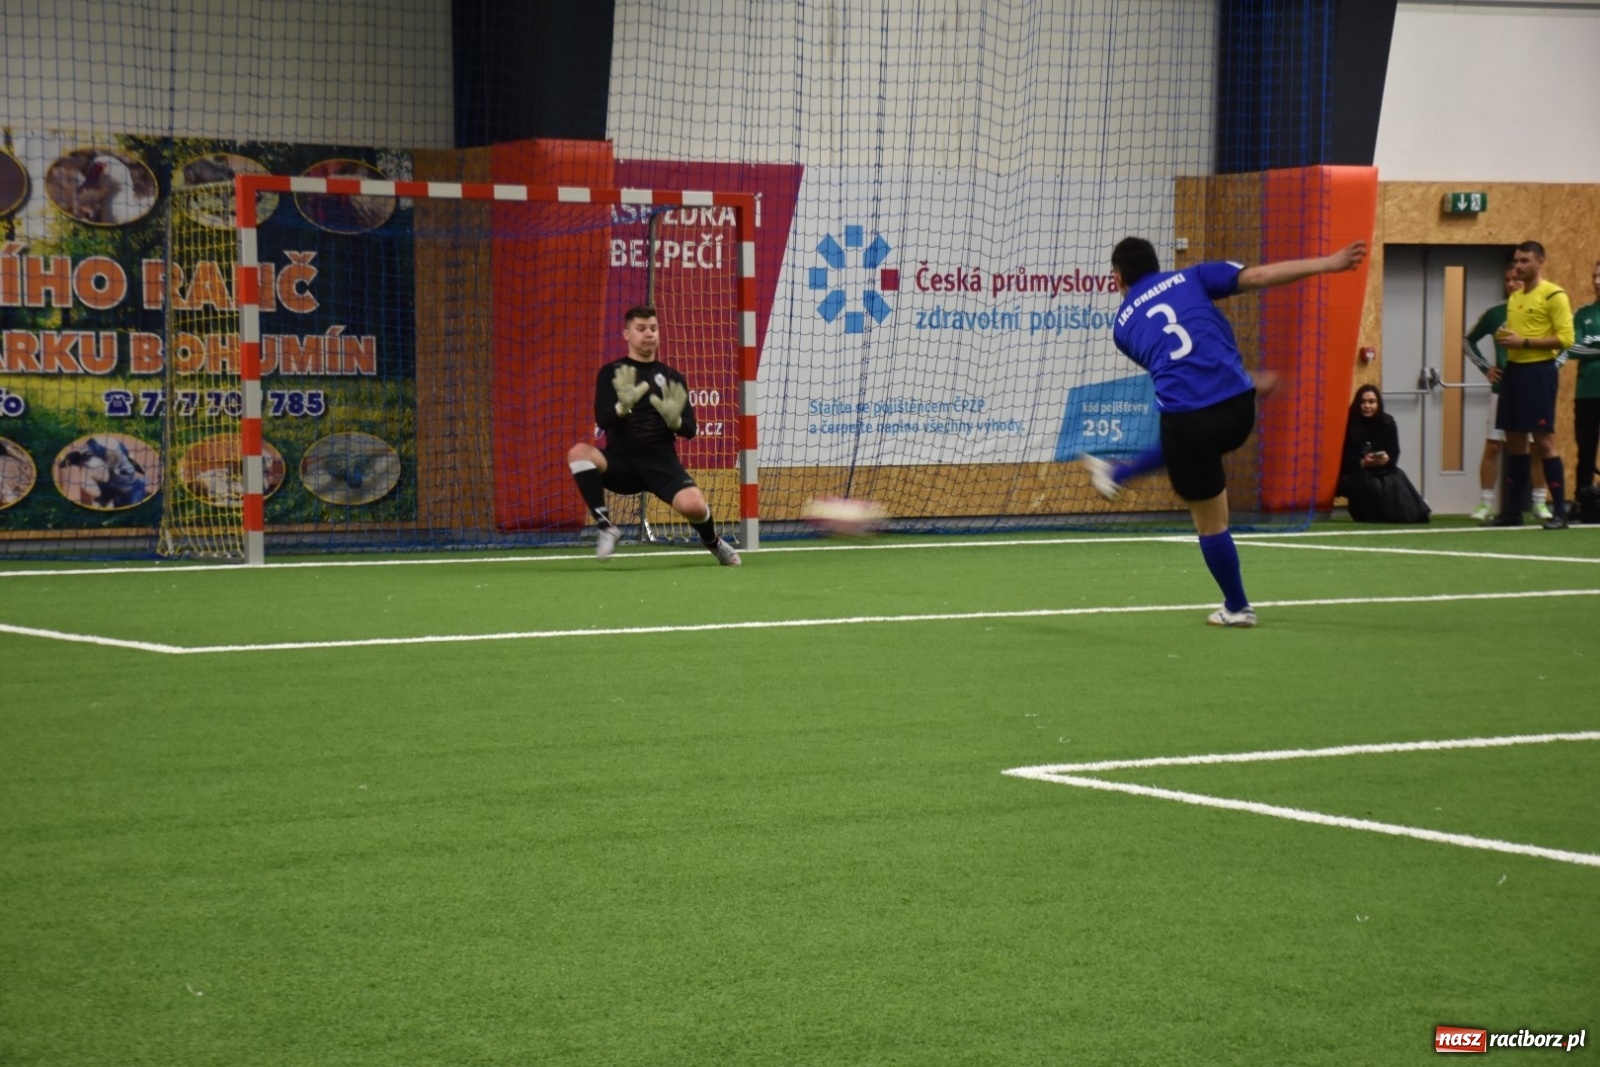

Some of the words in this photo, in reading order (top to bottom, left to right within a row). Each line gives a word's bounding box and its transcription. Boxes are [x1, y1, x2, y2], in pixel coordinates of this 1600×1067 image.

[662, 191, 763, 227] ZDRAÍ
[610, 233, 724, 269] BEZPEČÍ
[916, 260, 982, 292] Česká
[992, 266, 1119, 298] průmyslová
[915, 304, 1021, 330] zdravotní
[1030, 304, 1114, 336] pojišťov
[1118, 305, 1134, 327] LKS
[1145, 303, 1193, 360] 3
[268, 390, 325, 416] 785
[874, 399, 949, 417] pojištěncem
[809, 423, 817, 434] a
[1082, 418, 1124, 442] 205
